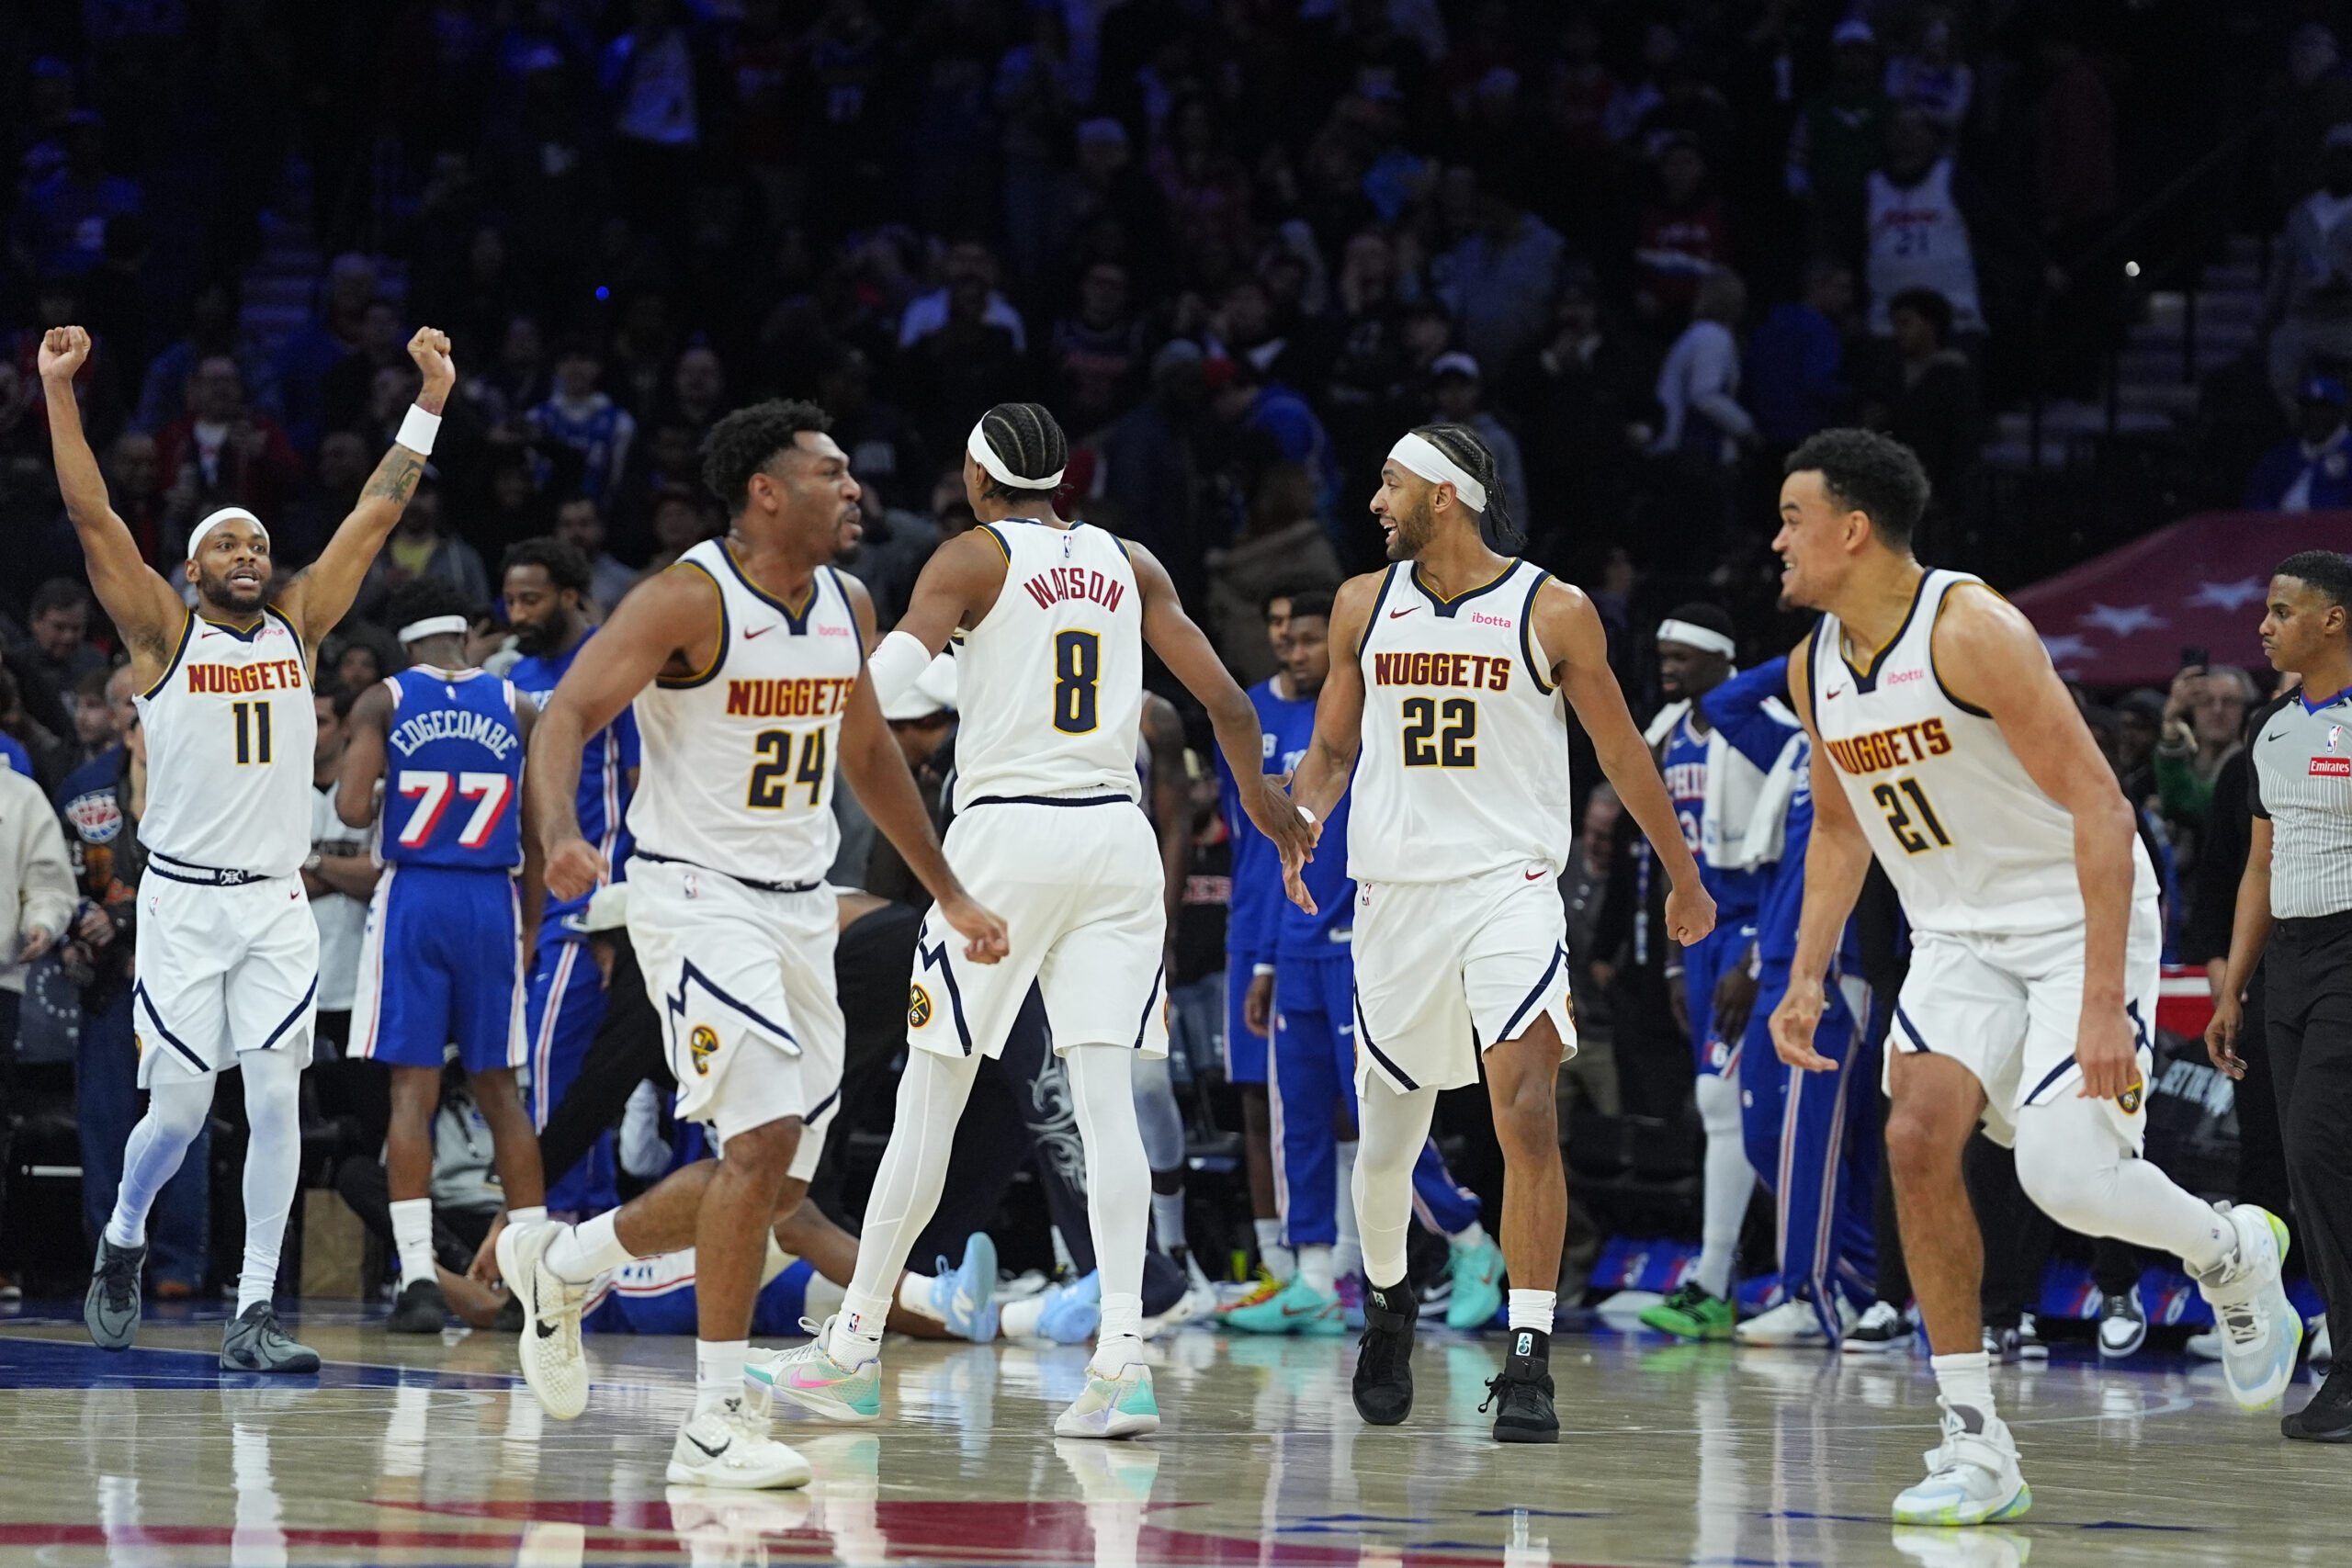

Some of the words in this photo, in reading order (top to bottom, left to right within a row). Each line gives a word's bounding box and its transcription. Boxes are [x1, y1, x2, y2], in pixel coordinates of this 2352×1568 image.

[1023, 567, 1125, 614] WATSON
[1472, 612, 1511, 628] ibotta
[187, 659, 301, 694] NUGGETS
[1053, 628, 1100, 735] 8
[1374, 652, 1511, 692] NUGGETS
[232, 701, 272, 766] 11
[390, 710, 518, 761] EDGECOMBE
[1402, 696, 1476, 769] 22
[1823, 716, 1952, 775] NUGGETS
[747, 725, 827, 810] 24
[2311, 760, 2350, 773] Emirates
[398, 770, 514, 849] 77
[1871, 777, 1952, 855] 21
